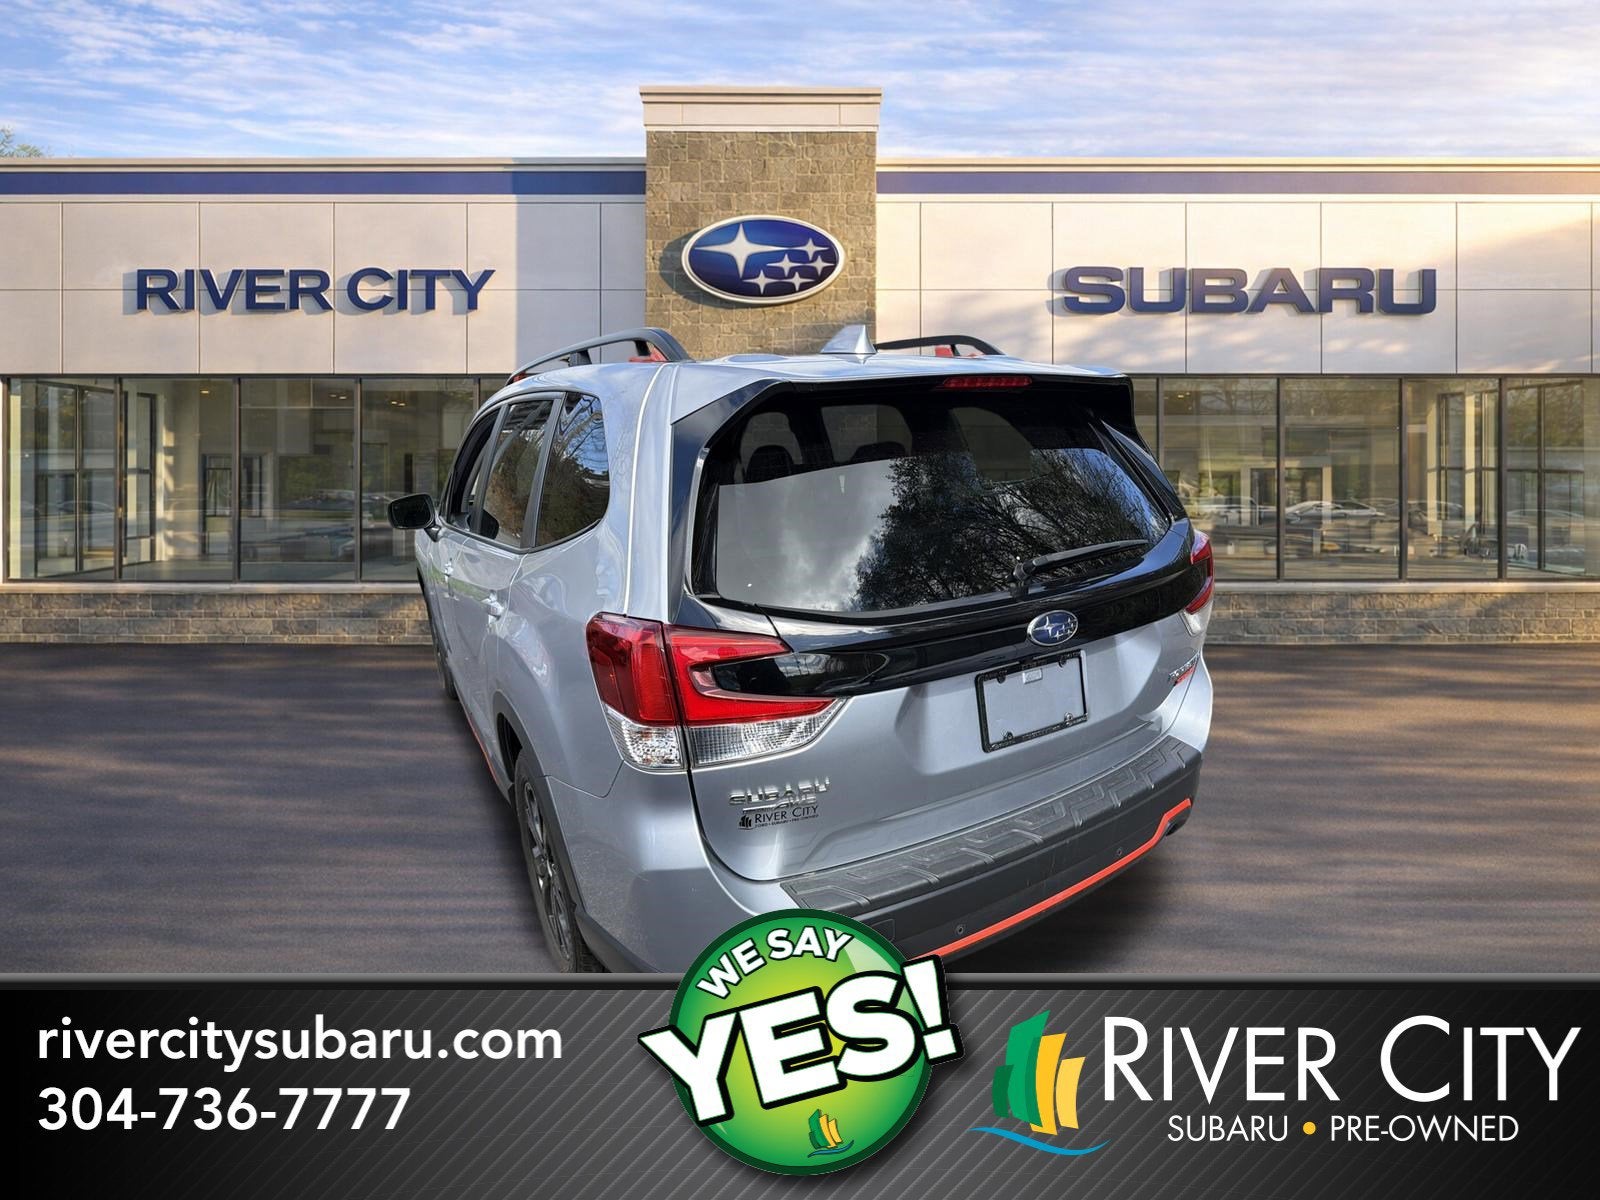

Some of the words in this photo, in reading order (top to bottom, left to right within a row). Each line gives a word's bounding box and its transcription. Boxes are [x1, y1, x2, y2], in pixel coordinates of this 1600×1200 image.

[136, 268, 334, 311] RIVER
[346, 267, 496, 312] CITY
[1062, 266, 1438, 315] SUBARU
[755, 810, 788, 824] RIVER
[792, 805, 819, 818] CITY
